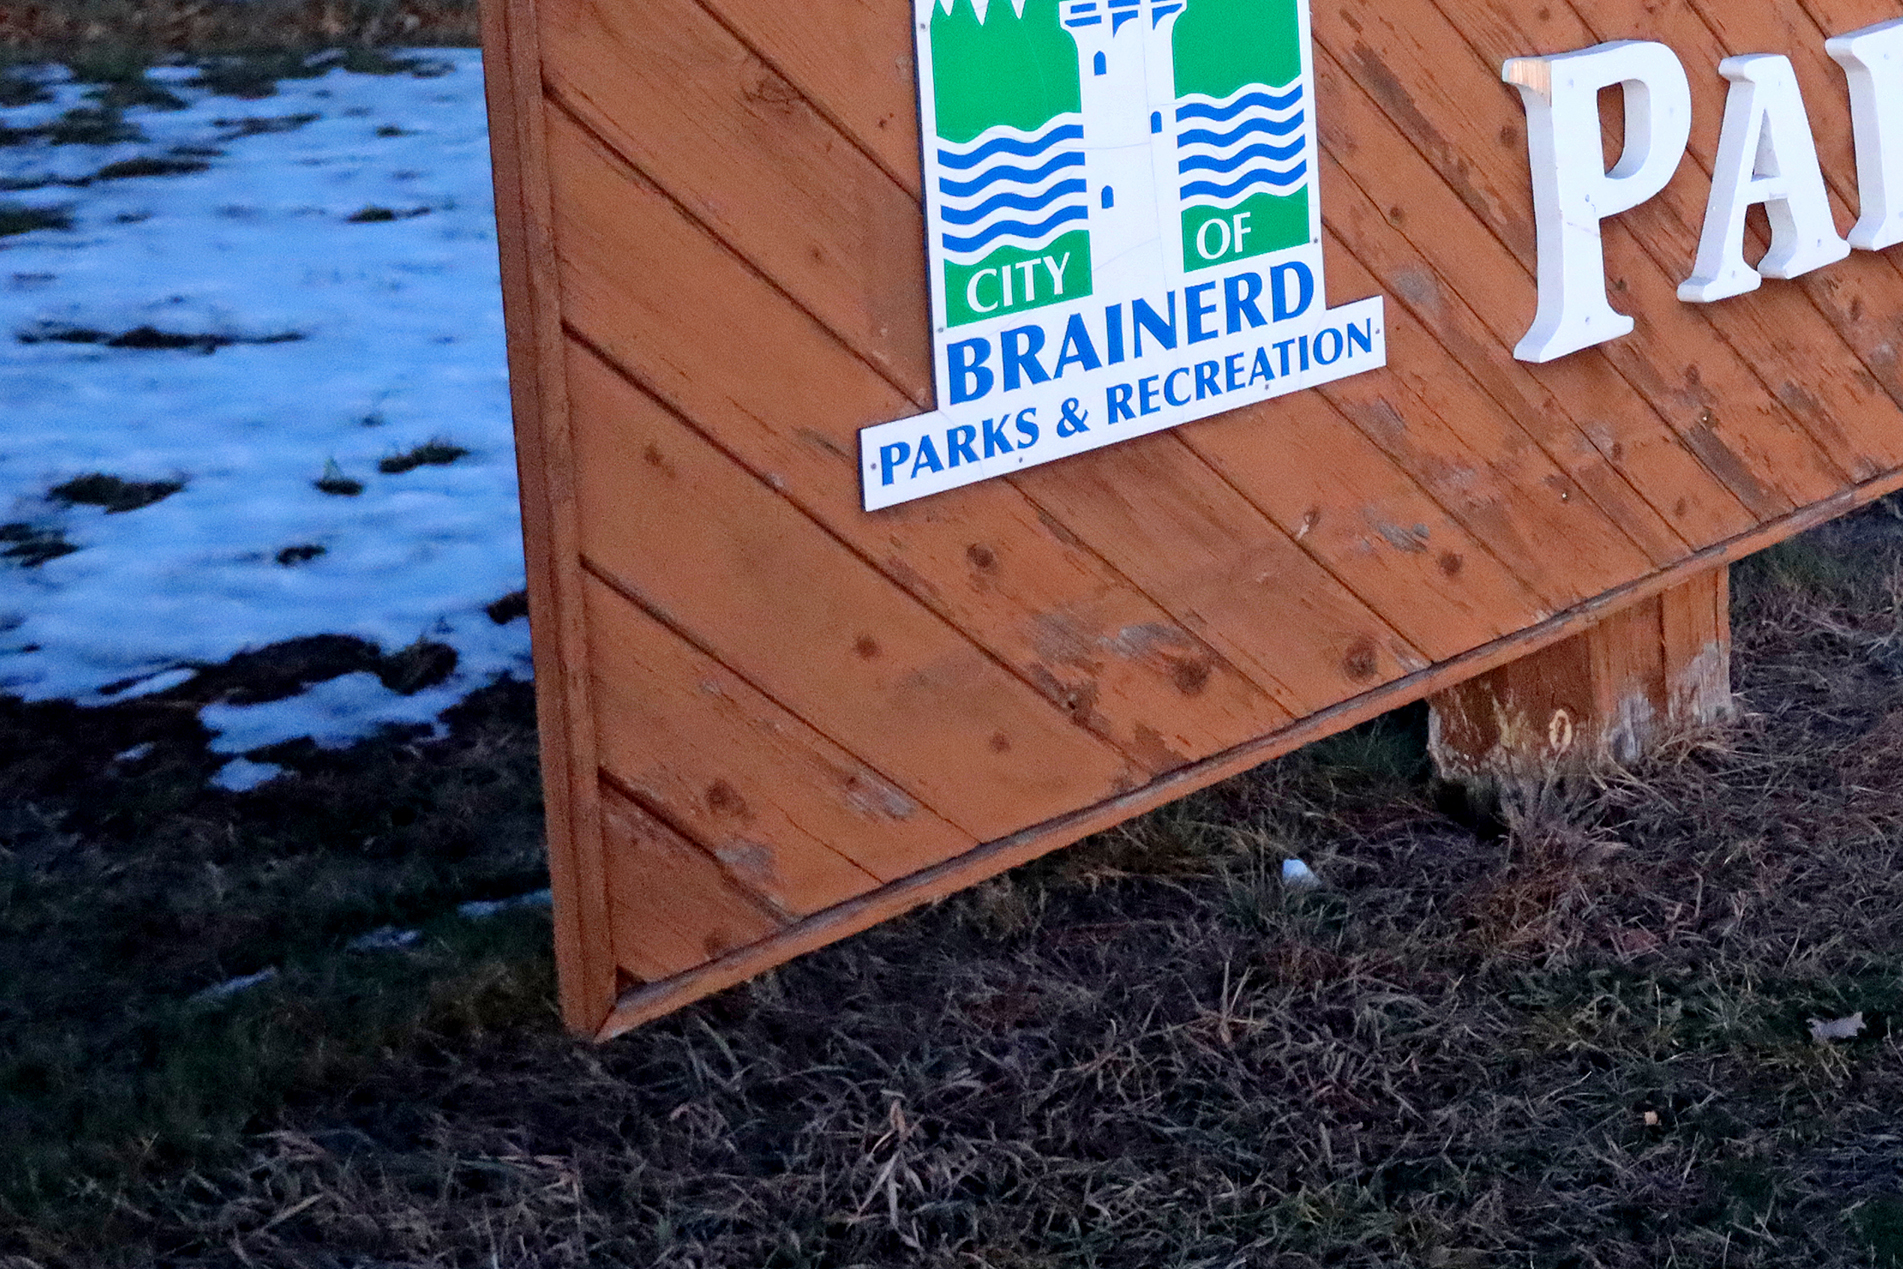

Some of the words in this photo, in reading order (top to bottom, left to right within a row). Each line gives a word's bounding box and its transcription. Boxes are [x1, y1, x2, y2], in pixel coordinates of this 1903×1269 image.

[946, 260, 1315, 406] BRAINERD
[966, 251, 1071, 314] CITY
[1196, 211, 1252, 260] OF
[879, 406, 1040, 488] PARKS
[1056, 396, 1091, 438] &
[1106, 317, 1373, 426] RECREATION
